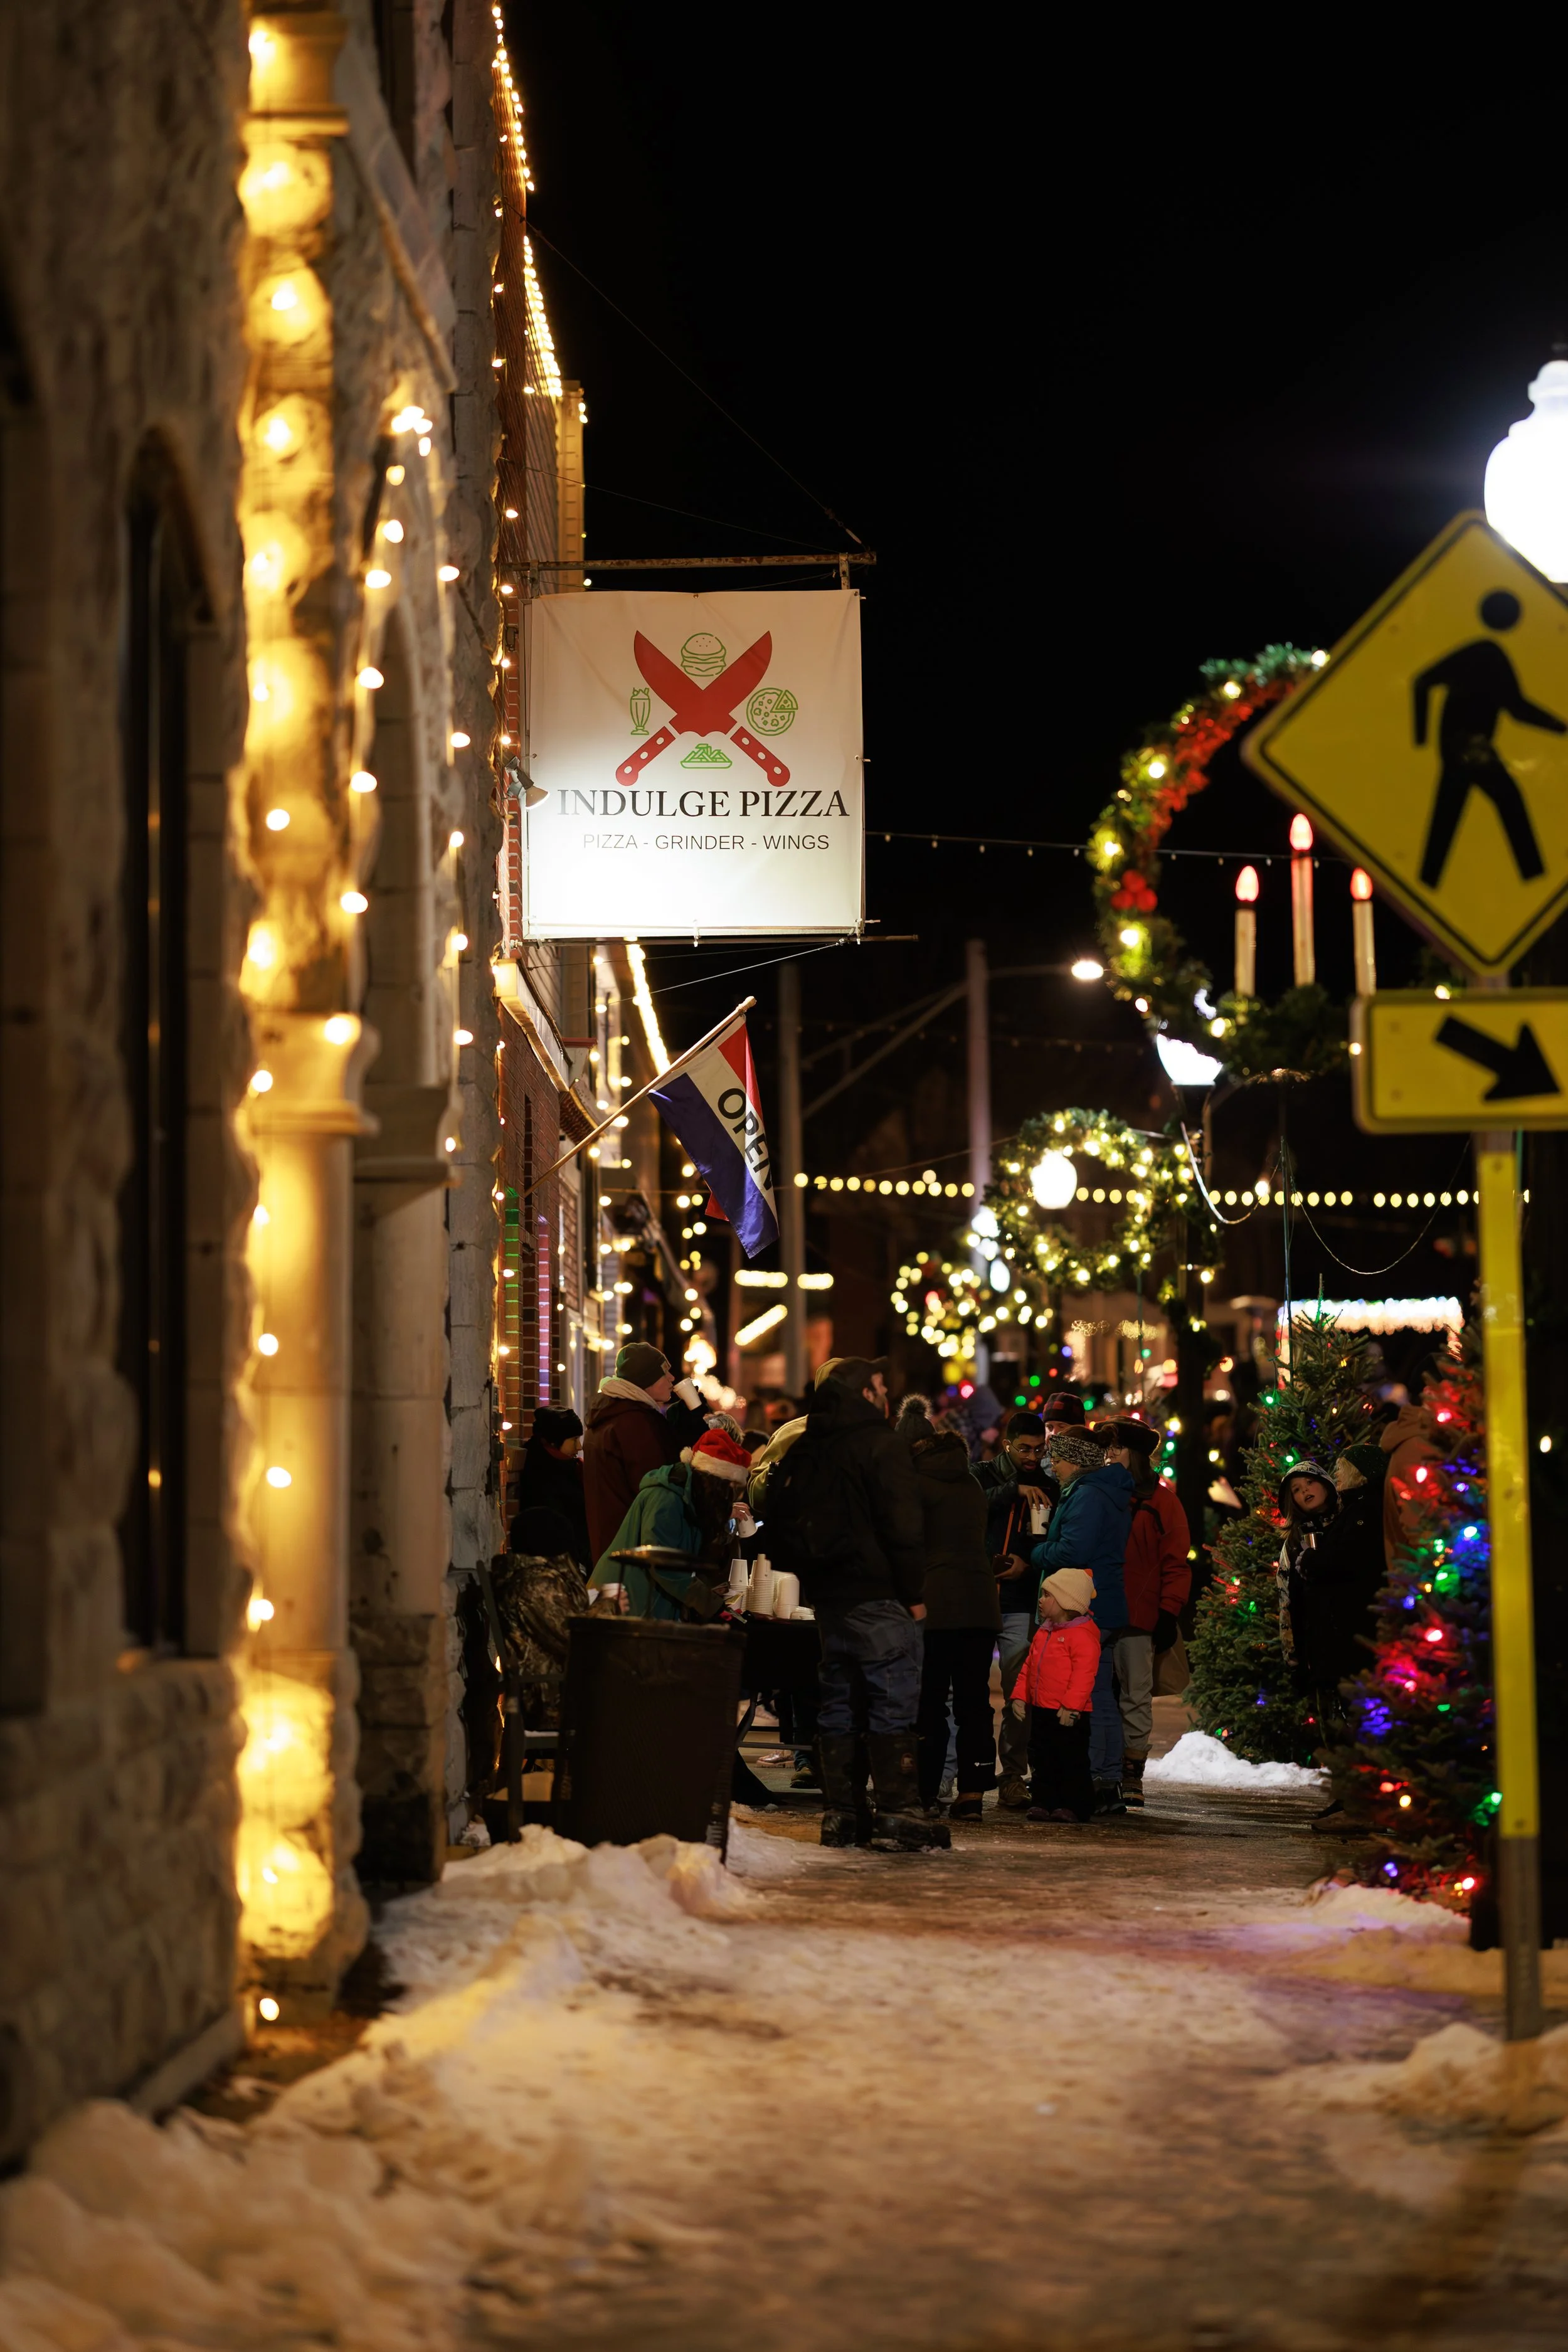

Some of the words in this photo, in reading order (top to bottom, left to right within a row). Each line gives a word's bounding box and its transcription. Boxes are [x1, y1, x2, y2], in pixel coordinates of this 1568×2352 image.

[557, 789, 731, 817] INDULGE
[739, 789, 850, 817] PIZZA
[583, 834, 638, 849] PIZZA
[655, 835, 744, 850] GRINDER
[763, 834, 830, 850] WINGS
